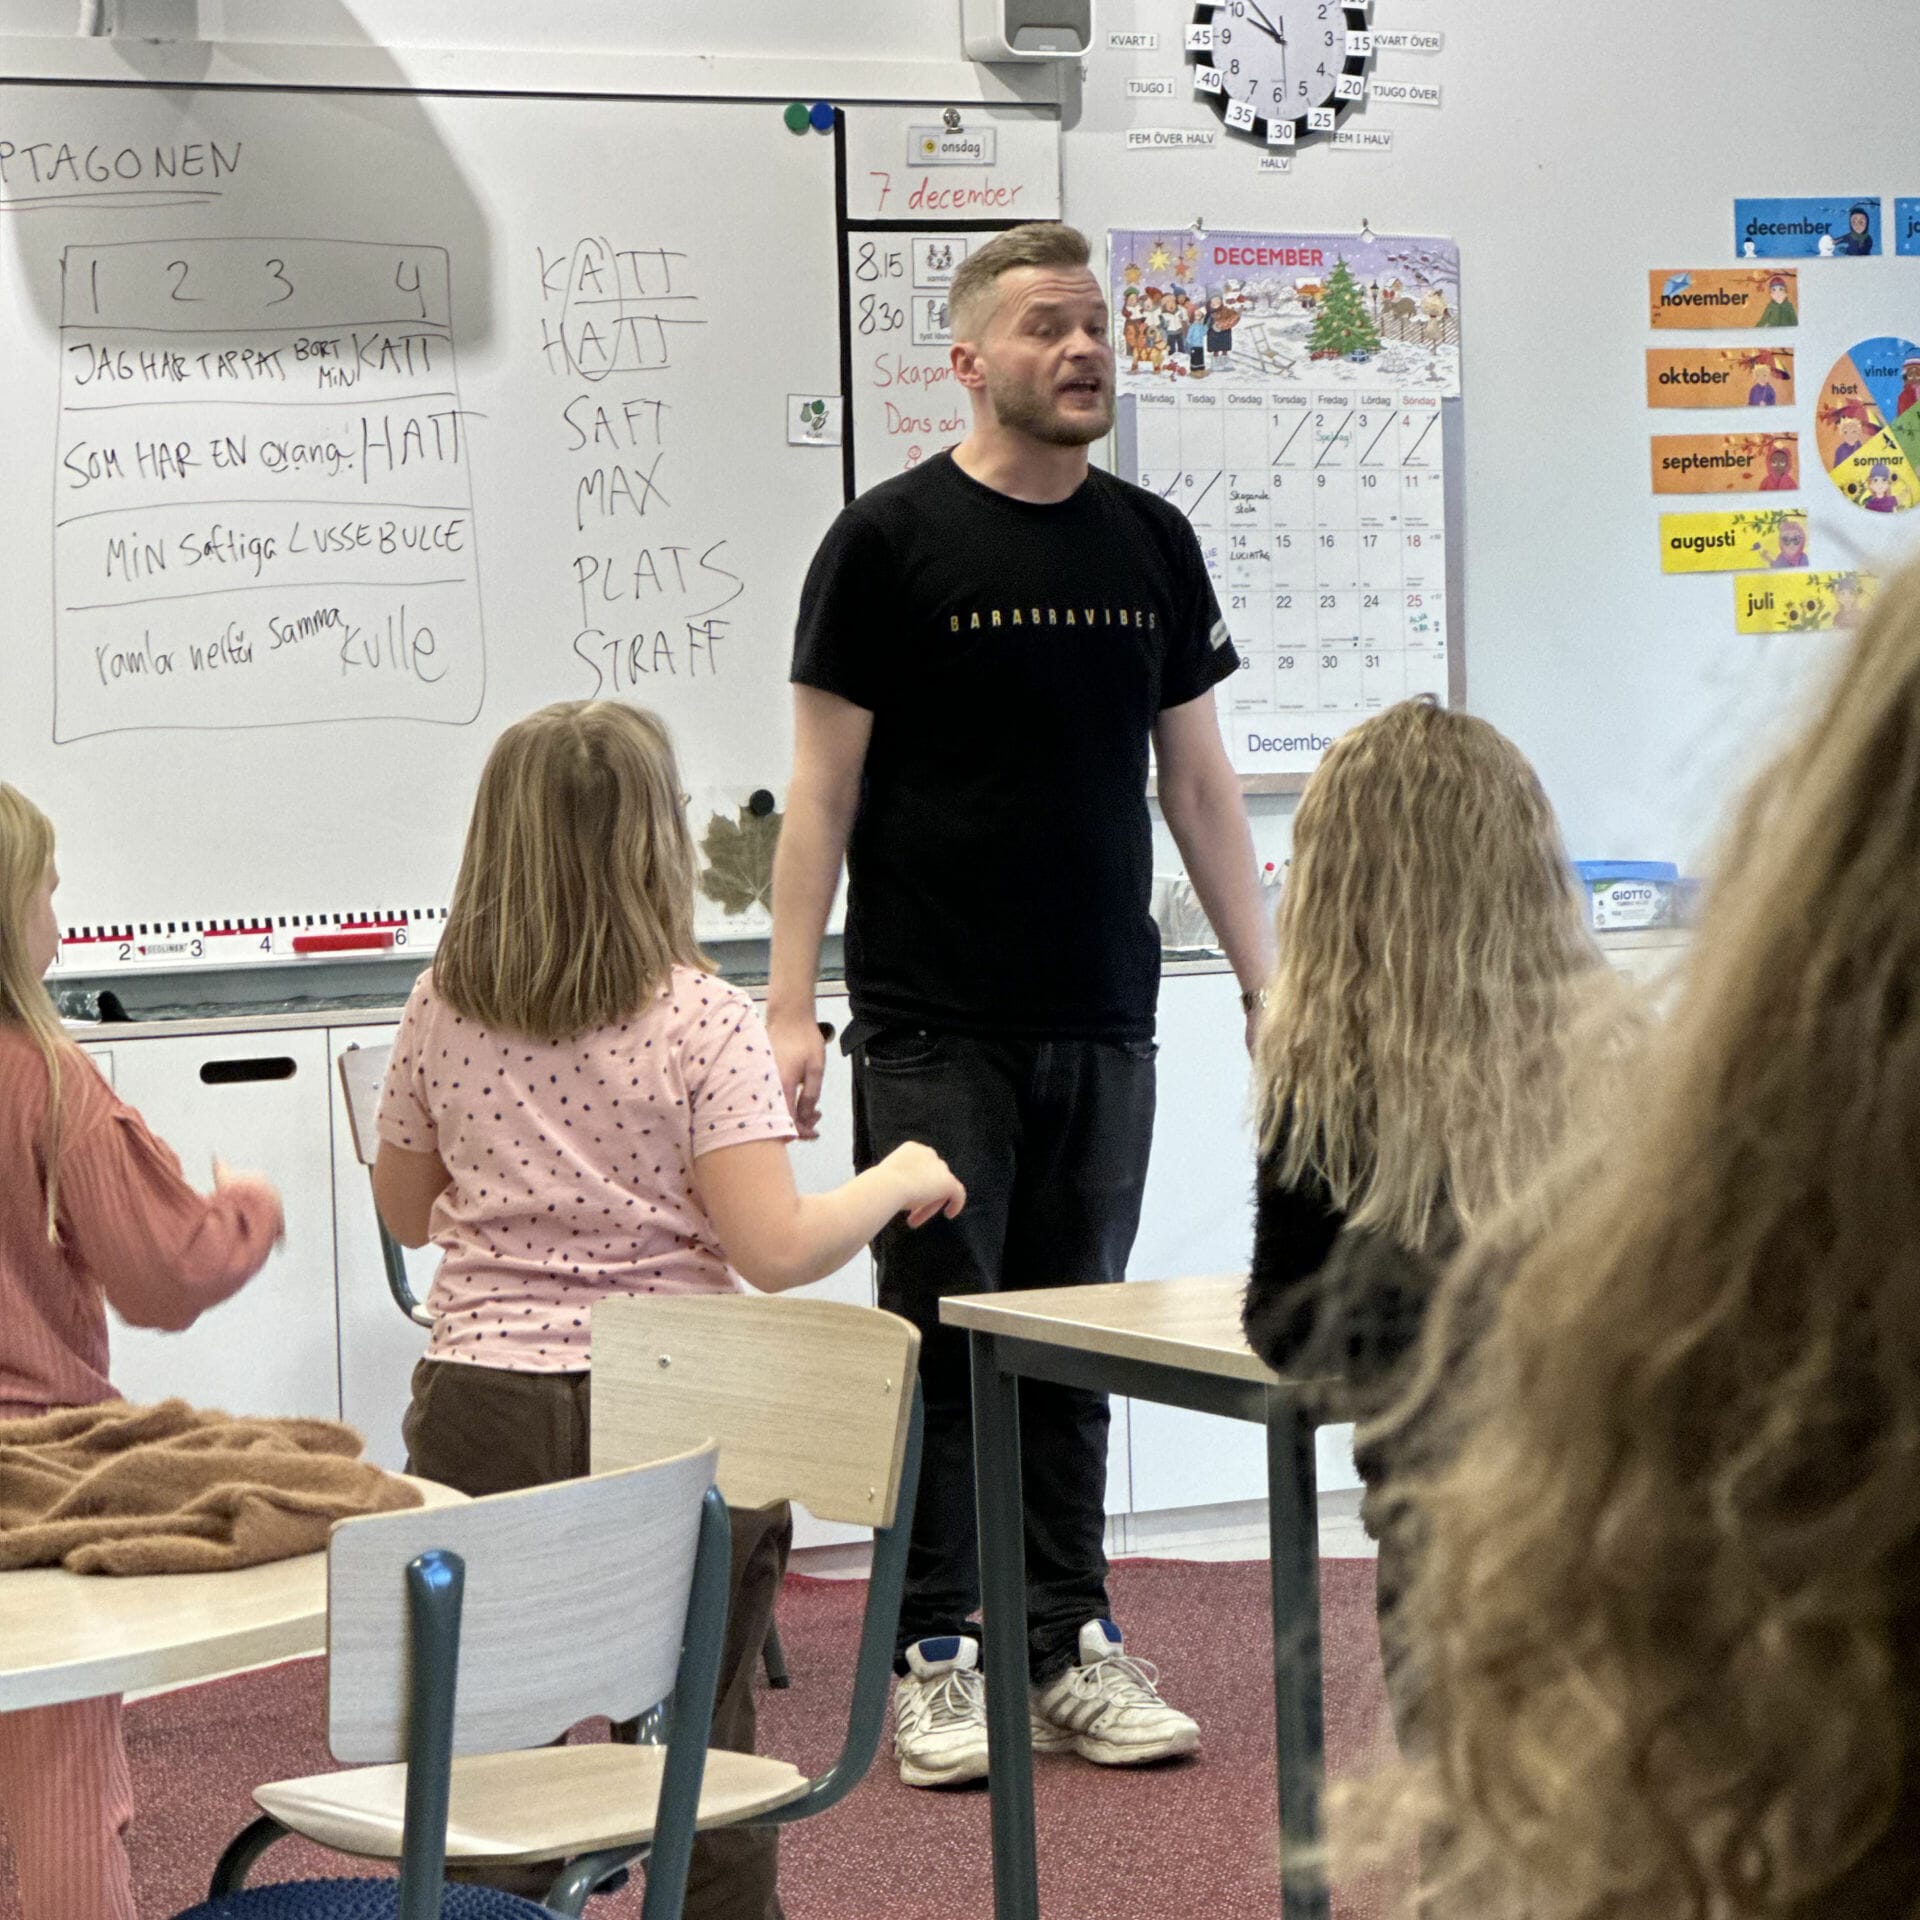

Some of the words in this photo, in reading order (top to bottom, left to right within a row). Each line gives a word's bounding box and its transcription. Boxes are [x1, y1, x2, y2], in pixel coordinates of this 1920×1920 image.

[1229, 2, 1245, 17] 10
[1317, 4, 1327, 20] 2
[1110, 34, 1144, 47] KVART
[1149, 34, 1155, 47] I
[1187, 30, 1211, 44] .45
[1221, 28, 1232, 44] 9
[1324, 31, 1334, 46] 3
[1348, 37, 1371, 51] .15
[1374, 34, 1405, 48] KVART
[1230, 59, 1240, 74] 8
[1316, 62, 1326, 77] 4
[1130, 81, 1165, 94] TJUGO
[1249, 80, 1258, 95] 7
[1272, 87, 1283, 103] 6
[1298, 81, 1308, 97] 5
[1338, 80, 1361, 96] .20
[1373, 85, 1405, 99] TJUGO
[1228, 106, 1251, 123] .35
[1308, 113, 1331, 128] .25
[1129, 133, 1150, 145] FEM
[1187, 131, 1214, 144] HALV
[1269, 125, 1292, 139] .30
[1333, 132, 1353, 145] FEM
[1363, 133, 1391, 146] HALV
[941, 141, 981, 158] onsdag
[1261, 157, 1288, 170] HALV
[870, 172, 891, 211] 7
[909, 177, 1024, 211] december
[1746, 217, 1833, 236] december
[1214, 247, 1324, 266] DECEMBER
[537, 246, 690, 300] KATT
[167, 260, 205, 302] 2
[266, 258, 294, 306] 3
[395, 260, 427, 318] 4
[1660, 288, 1749, 307] november
[541, 313, 708, 375] HATT
[69, 343, 133, 385] JAG
[140, 350, 190, 382] HAR
[196, 348, 287, 381] TAPPAT
[294, 337, 341, 361] BORT
[352, 333, 450, 382] KATT
[1659, 366, 1730, 384] oktober
[1864, 364, 1899, 378] vinter
[1831, 383, 1858, 395] höst
[1140, 394, 1175, 406] Måndag
[1187, 394, 1216, 406] Tisdag
[1228, 394, 1262, 407] Onsdag
[1273, 394, 1307, 407] Torsdag
[1318, 395, 1348, 407] Fredag
[1361, 395, 1391, 407] Lördag
[1403, 395, 1436, 407] Söndag
[564, 395, 672, 450] SAFT
[884, 401, 933, 436] Dans
[938, 406, 967, 433] och
[1272, 414, 1280, 427] 1
[1315, 414, 1324, 427] 2
[1359, 414, 1368, 427] 3
[1402, 414, 1411, 427] 4
[63, 442, 124, 488] SOM
[136, 441, 202, 480] HAR
[209, 435, 247, 468] EN
[362, 409, 489, 484] HATT
[1662, 450, 1754, 474] september
[1853, 456, 1905, 467] sommar
[1141, 474, 1150, 487] 5
[1185, 474, 1193, 487] 6
[1229, 474, 1238, 487] 7
[1273, 475, 1282, 487] 8
[1317, 475, 1326, 487] 9
[1361, 475, 1376, 487] 10
[1405, 475, 1419, 488] 11
[576, 452, 672, 531] MAX
[1231, 535, 1247, 548] 14
[1275, 535, 1291, 548] 15
[1319, 535, 1335, 548] 16
[1363, 535, 1378, 548] 17
[1406, 534, 1422, 548] 18
[1671, 530, 1735, 552] augusti
[573, 540, 744, 628] PLATS
[1232, 596, 1247, 609] 21
[1276, 596, 1292, 609] 22
[1320, 596, 1336, 608] 23
[1363, 595, 1379, 608] 24
[1406, 594, 1423, 607] 25
[1747, 592, 1774, 616] juli
[573, 619, 731, 703] STRAFF
[1278, 656, 1294, 669] 29
[1322, 655, 1338, 668] 30
[1365, 655, 1380, 668] 31
[1248, 733, 1336, 752] Decembe
[1611, 889, 1652, 901] GIOTTO
[260, 936, 272, 953] 4
[395, 928, 407, 946] 6
[119, 943, 132, 961] 2
[190, 939, 203, 957] 3
